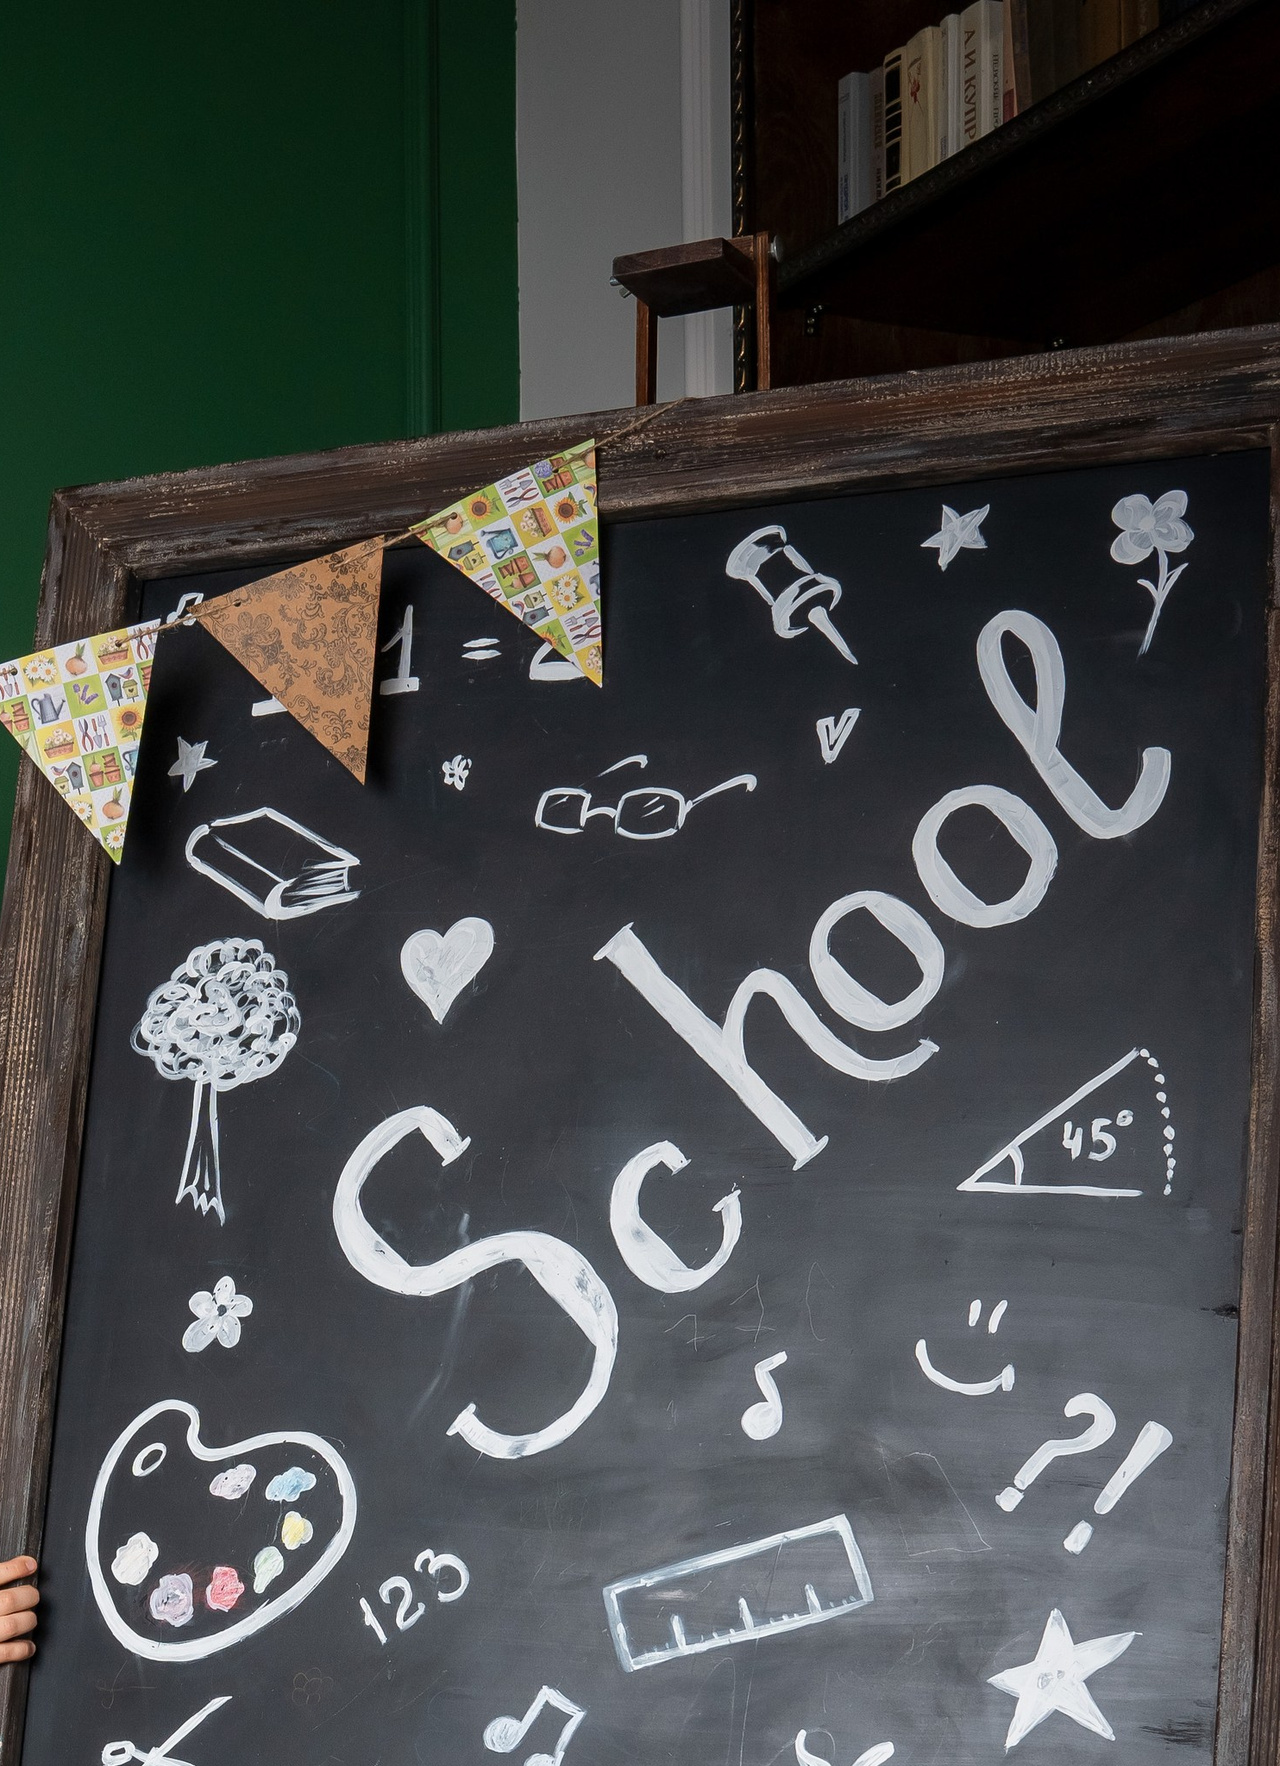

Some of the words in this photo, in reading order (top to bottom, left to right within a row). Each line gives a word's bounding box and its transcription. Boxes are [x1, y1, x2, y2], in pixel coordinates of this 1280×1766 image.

[963, 68, 976, 140] КУПР
[380, 604, 419, 696] 1
[333, 609, 1172, 1459] School
[359, 1547, 472, 1646] 123
